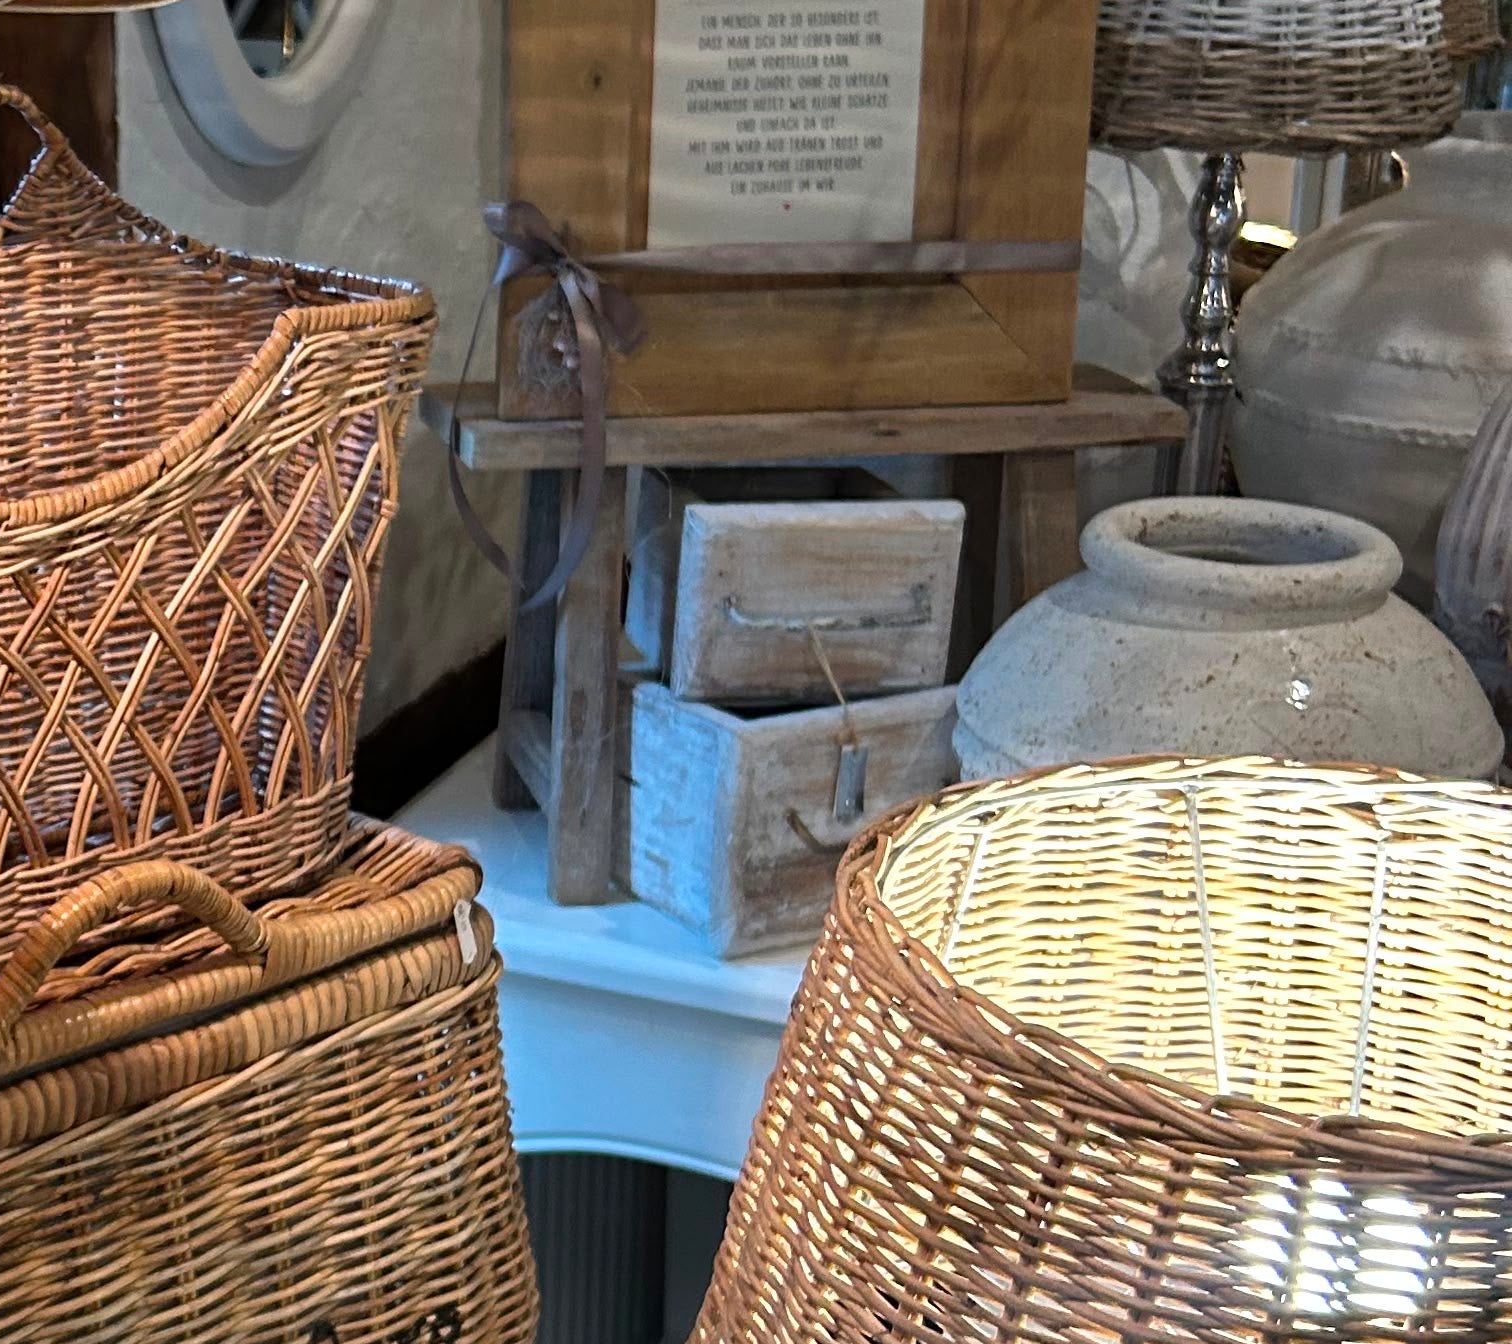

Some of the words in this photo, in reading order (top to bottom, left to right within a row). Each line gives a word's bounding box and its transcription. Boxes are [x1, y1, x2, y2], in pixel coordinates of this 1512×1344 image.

[727, 35, 750, 50] MAN
[836, 32, 859, 46] OHNE
[797, 74, 823, 89] OHNE
